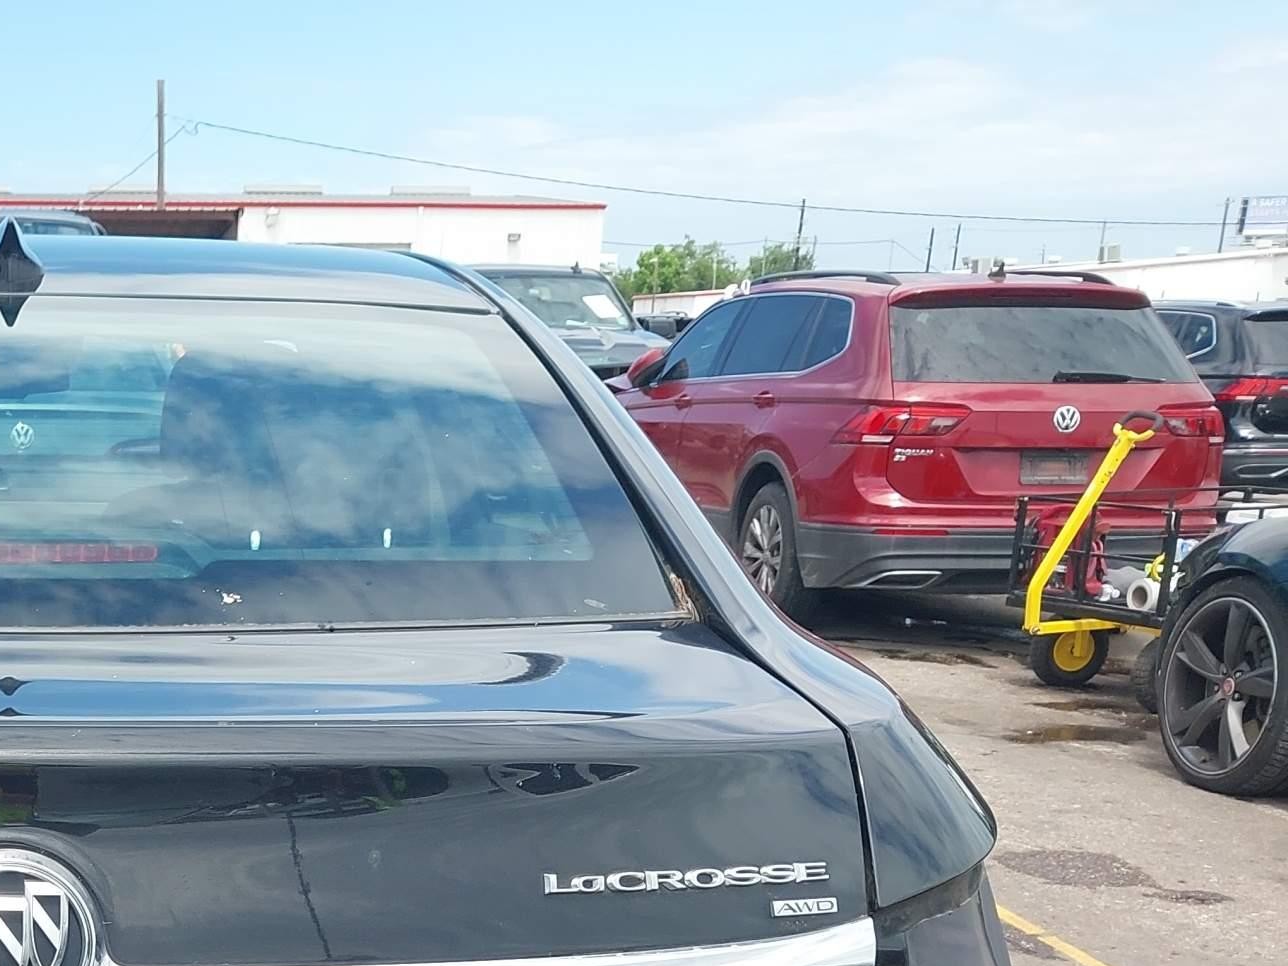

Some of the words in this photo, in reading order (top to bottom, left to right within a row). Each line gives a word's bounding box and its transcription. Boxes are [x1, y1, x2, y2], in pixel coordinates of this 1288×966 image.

[1053, 405, 1081, 433] VW
[543, 861, 831, 895] LaCROSSE
[776, 898, 835, 914] AWD
